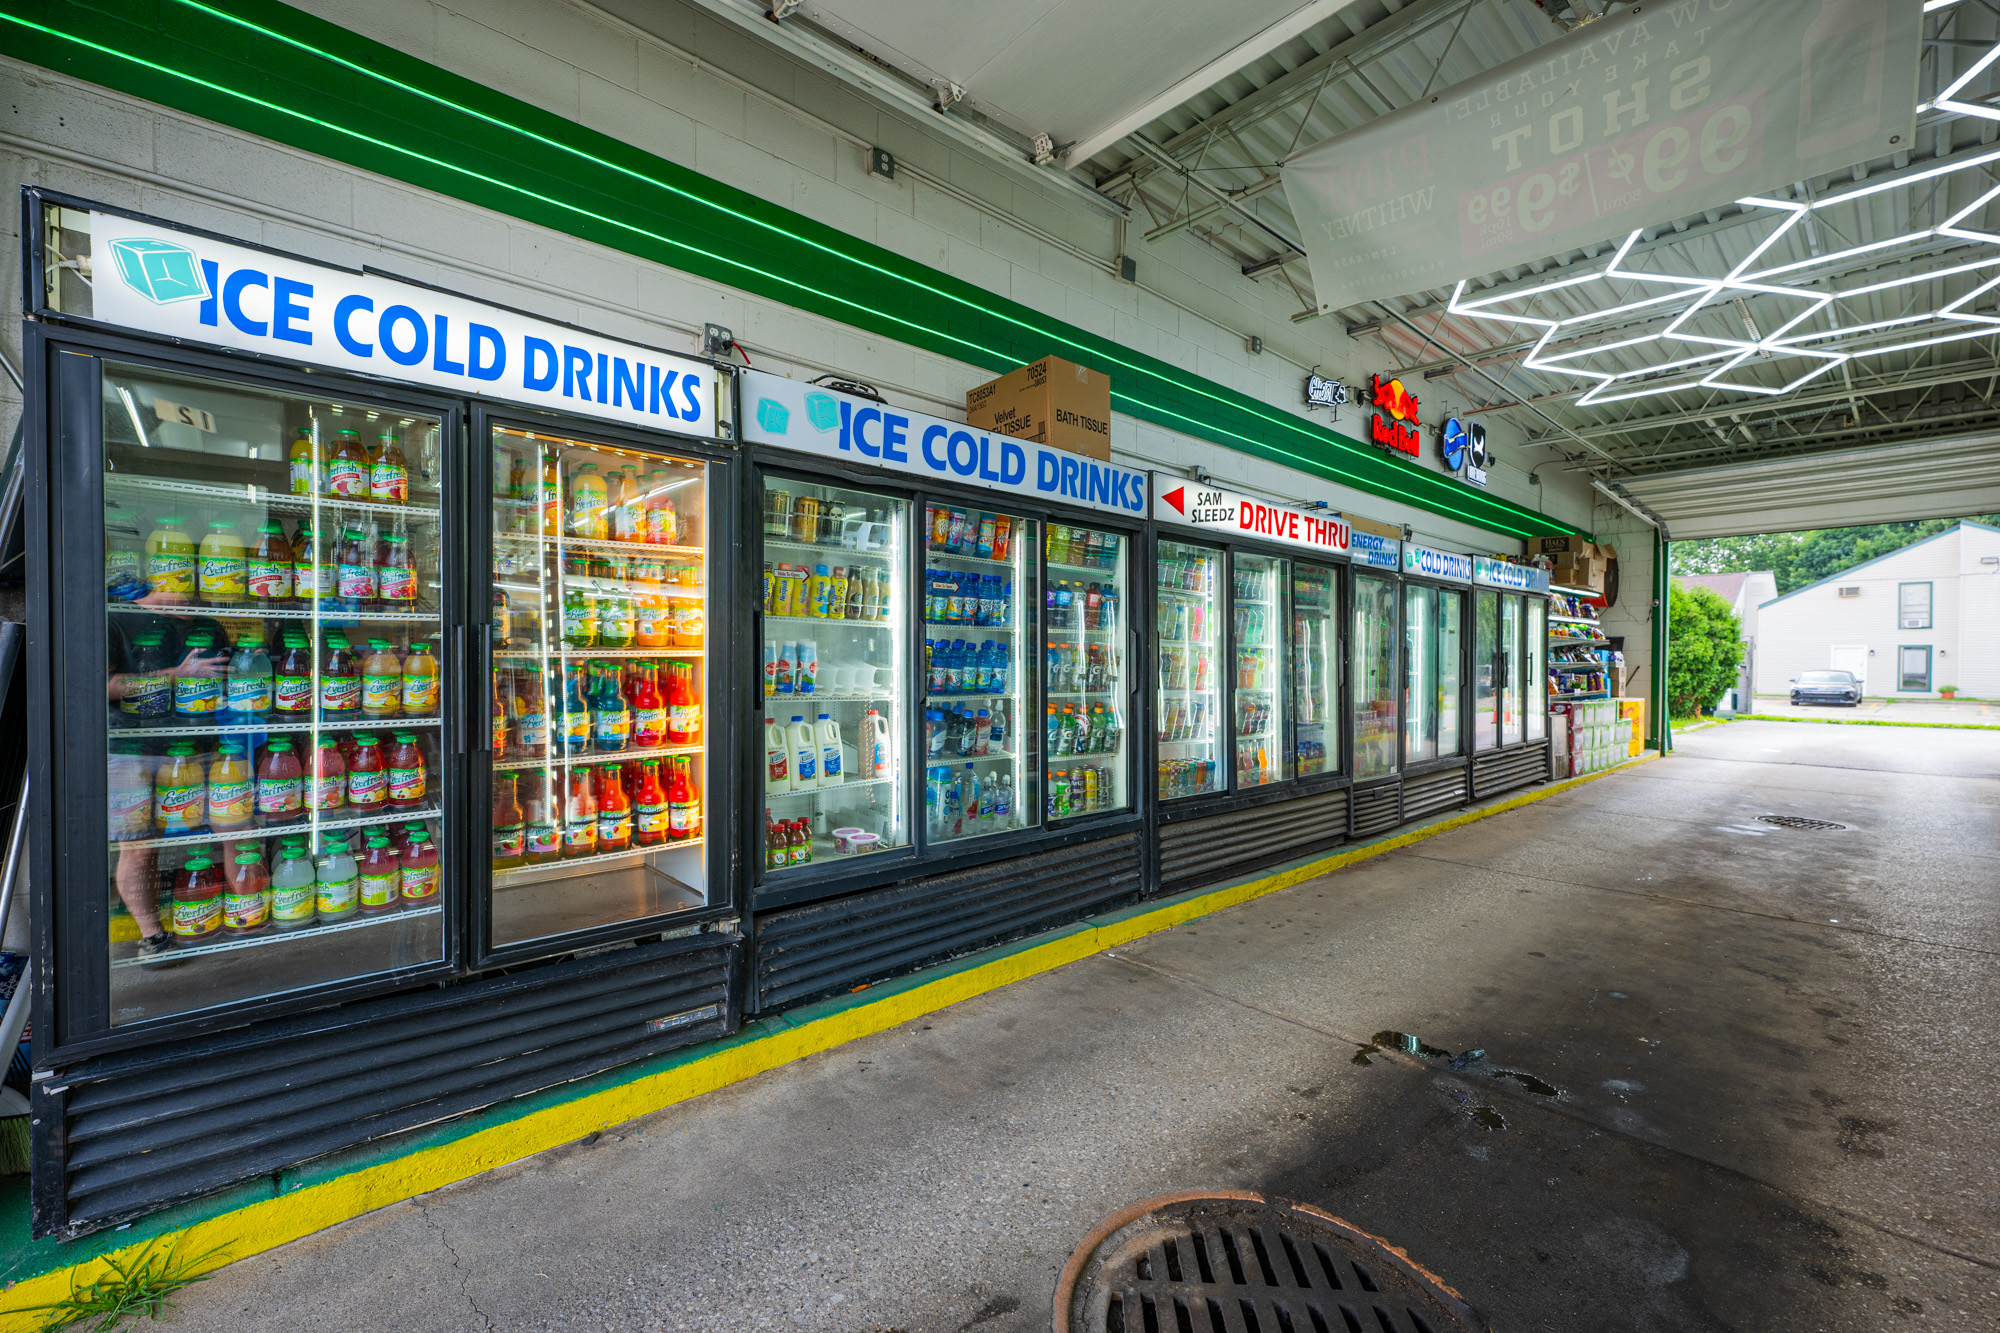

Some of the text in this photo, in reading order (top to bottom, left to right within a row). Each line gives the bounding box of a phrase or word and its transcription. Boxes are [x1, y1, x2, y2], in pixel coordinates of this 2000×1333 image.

[200, 258, 701, 423] ICE COLD DRINKS
[1026, 361, 1047, 381] 70524
[994, 407, 1016, 425] Velvet
[1056, 409, 1108, 435] BATH TISSUE
[1003, 415, 1031, 435] TISSUE
[1373, 413, 1420, 458] Red Bull
[839, 401, 1144, 512] ICE COLD DRINKS
[330, 462, 357, 476] erfresh
[373, 468, 406, 483] Everfresh
[1197, 492, 1222, 506] SAM
[1192, 508, 1235, 523] SLEEDZ
[1240, 501, 1349, 550] DRIVE THRU
[1351, 533, 1385, 550] ENERGY
[107, 553, 135, 567] fresh
[147, 557, 193, 574] Everfresh
[1367, 551, 1398, 566] DRINKS
[1421, 550, 1471, 580] COLD DRINKS
[203, 559, 245, 577] Everfresh
[249, 564, 280, 577] erfresh
[1489, 561, 1502, 583] ICE
[1503, 564, 1523, 587] COLD
[124, 678, 171, 697] Everfresh
[176, 678, 219, 696] Everfresh
[280, 680, 312, 695] Everfre
[326, 680, 361, 695] Everfre
[370, 680, 400, 694] Everfre
[411, 679, 434, 694] Everf
[527, 716, 545, 729] Everf
[211, 782, 252, 801] Everfresh
[403, 868, 430, 881] erfresh
[176, 897, 221, 921] Everfresh
